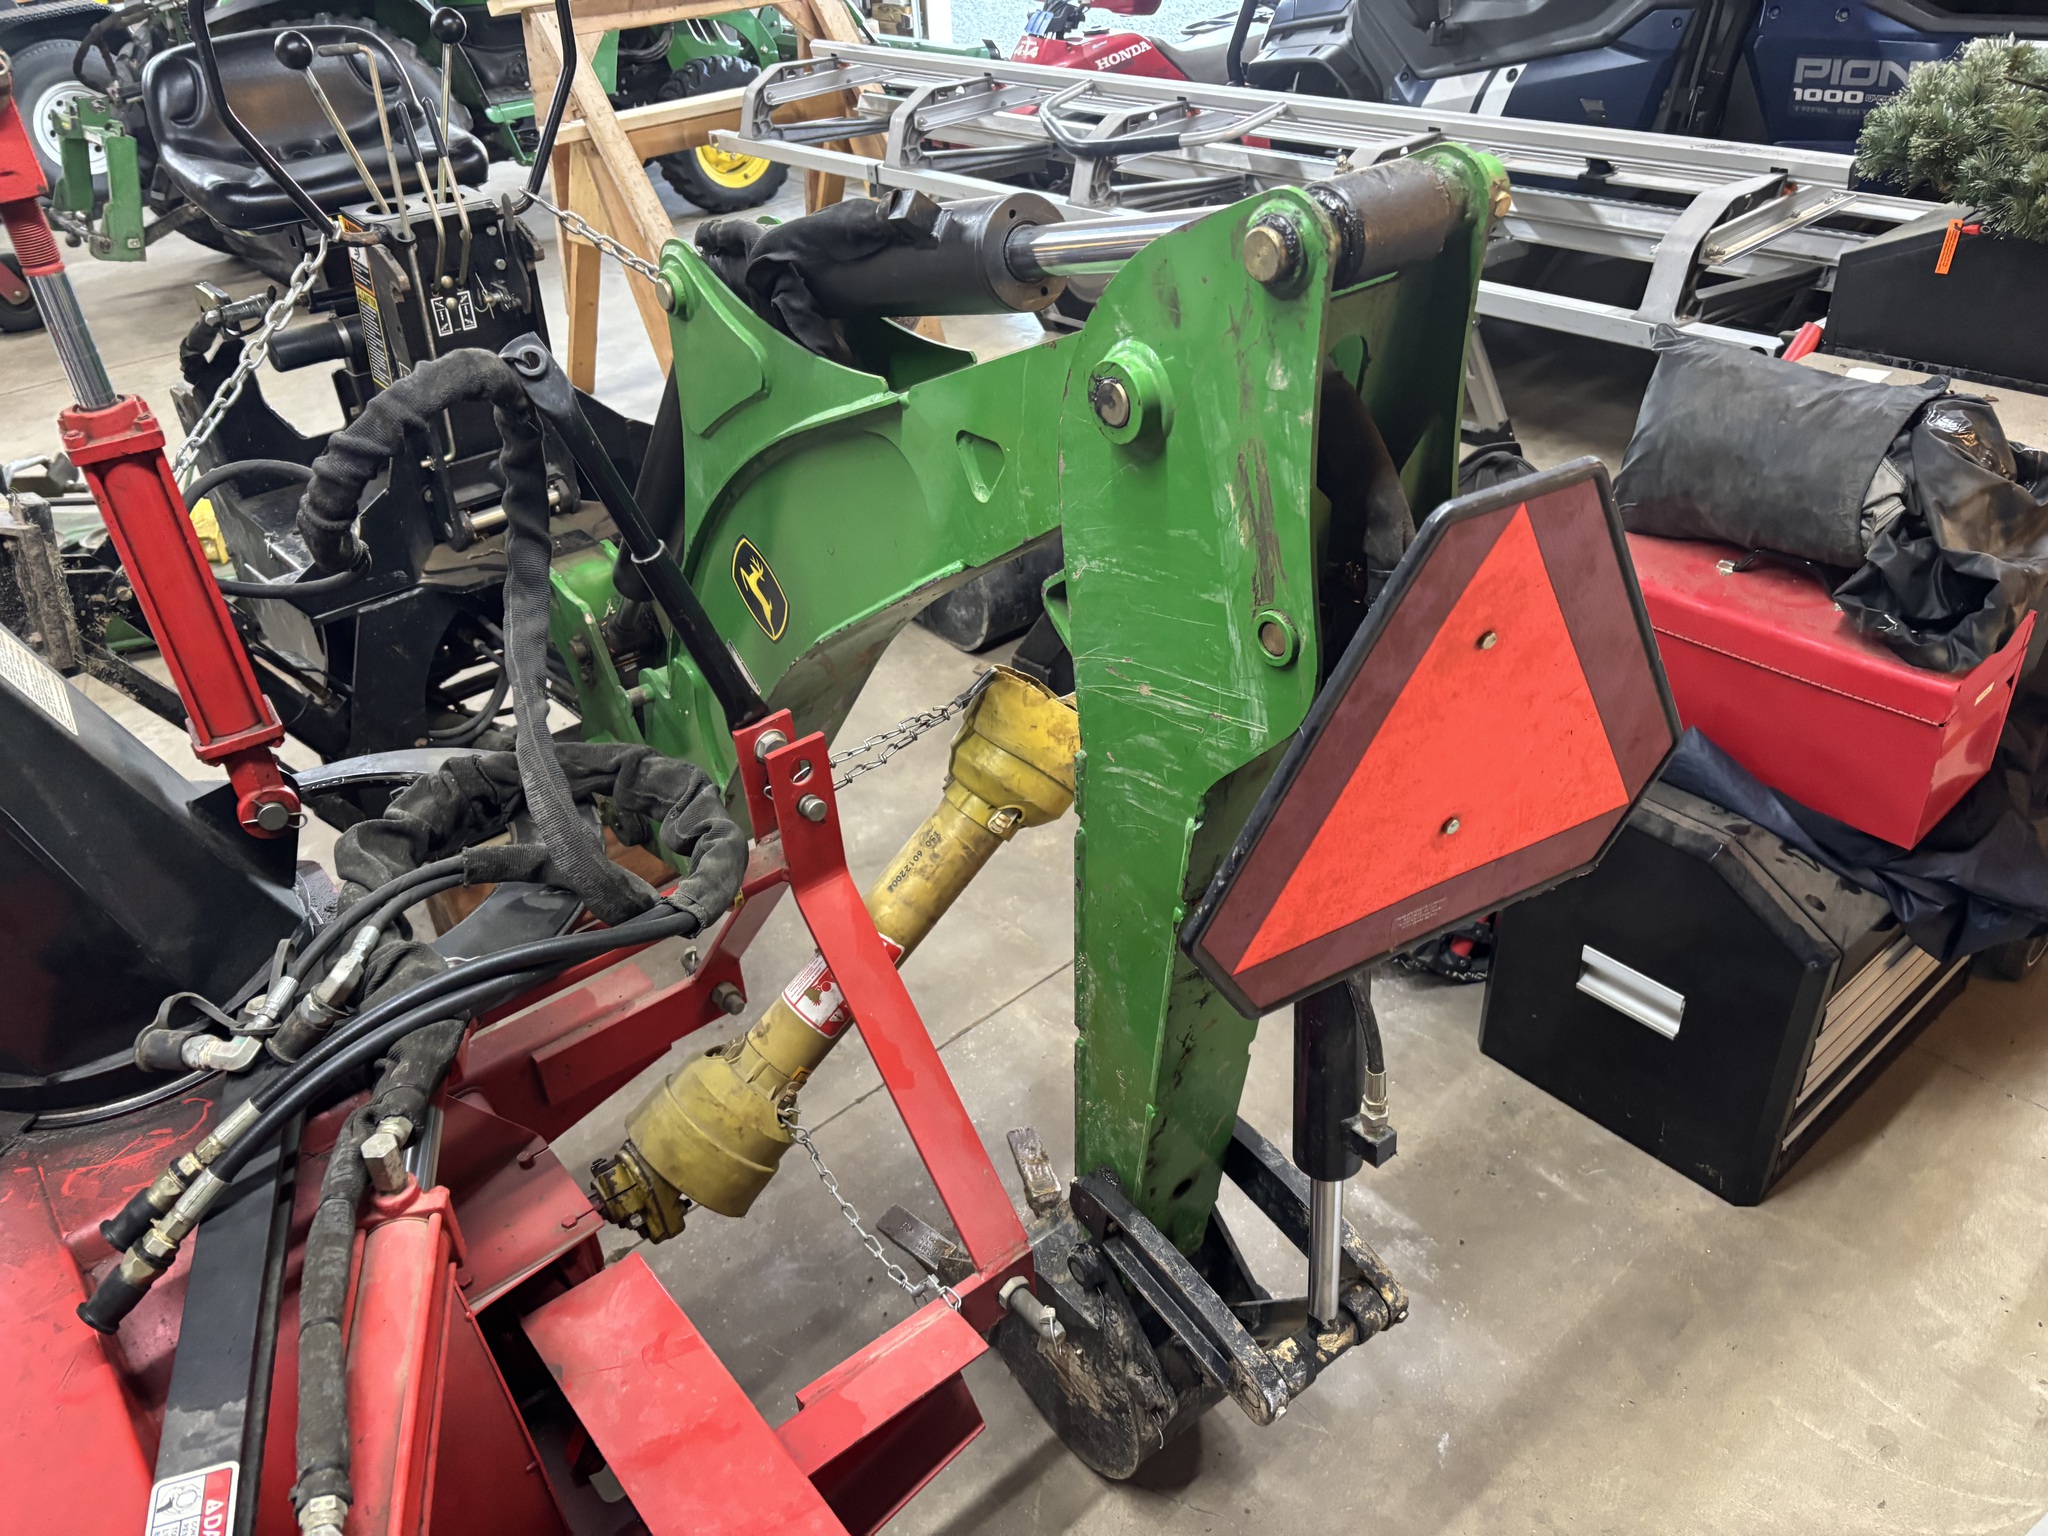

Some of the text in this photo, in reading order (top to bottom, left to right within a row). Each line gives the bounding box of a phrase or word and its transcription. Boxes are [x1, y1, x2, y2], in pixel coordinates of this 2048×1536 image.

[1095, 41, 1152, 71] HONDA
[1793, 57, 1918, 87] PION
[1793, 87, 1865, 104] 1000
[1836, 107, 1869, 115] EDIT
